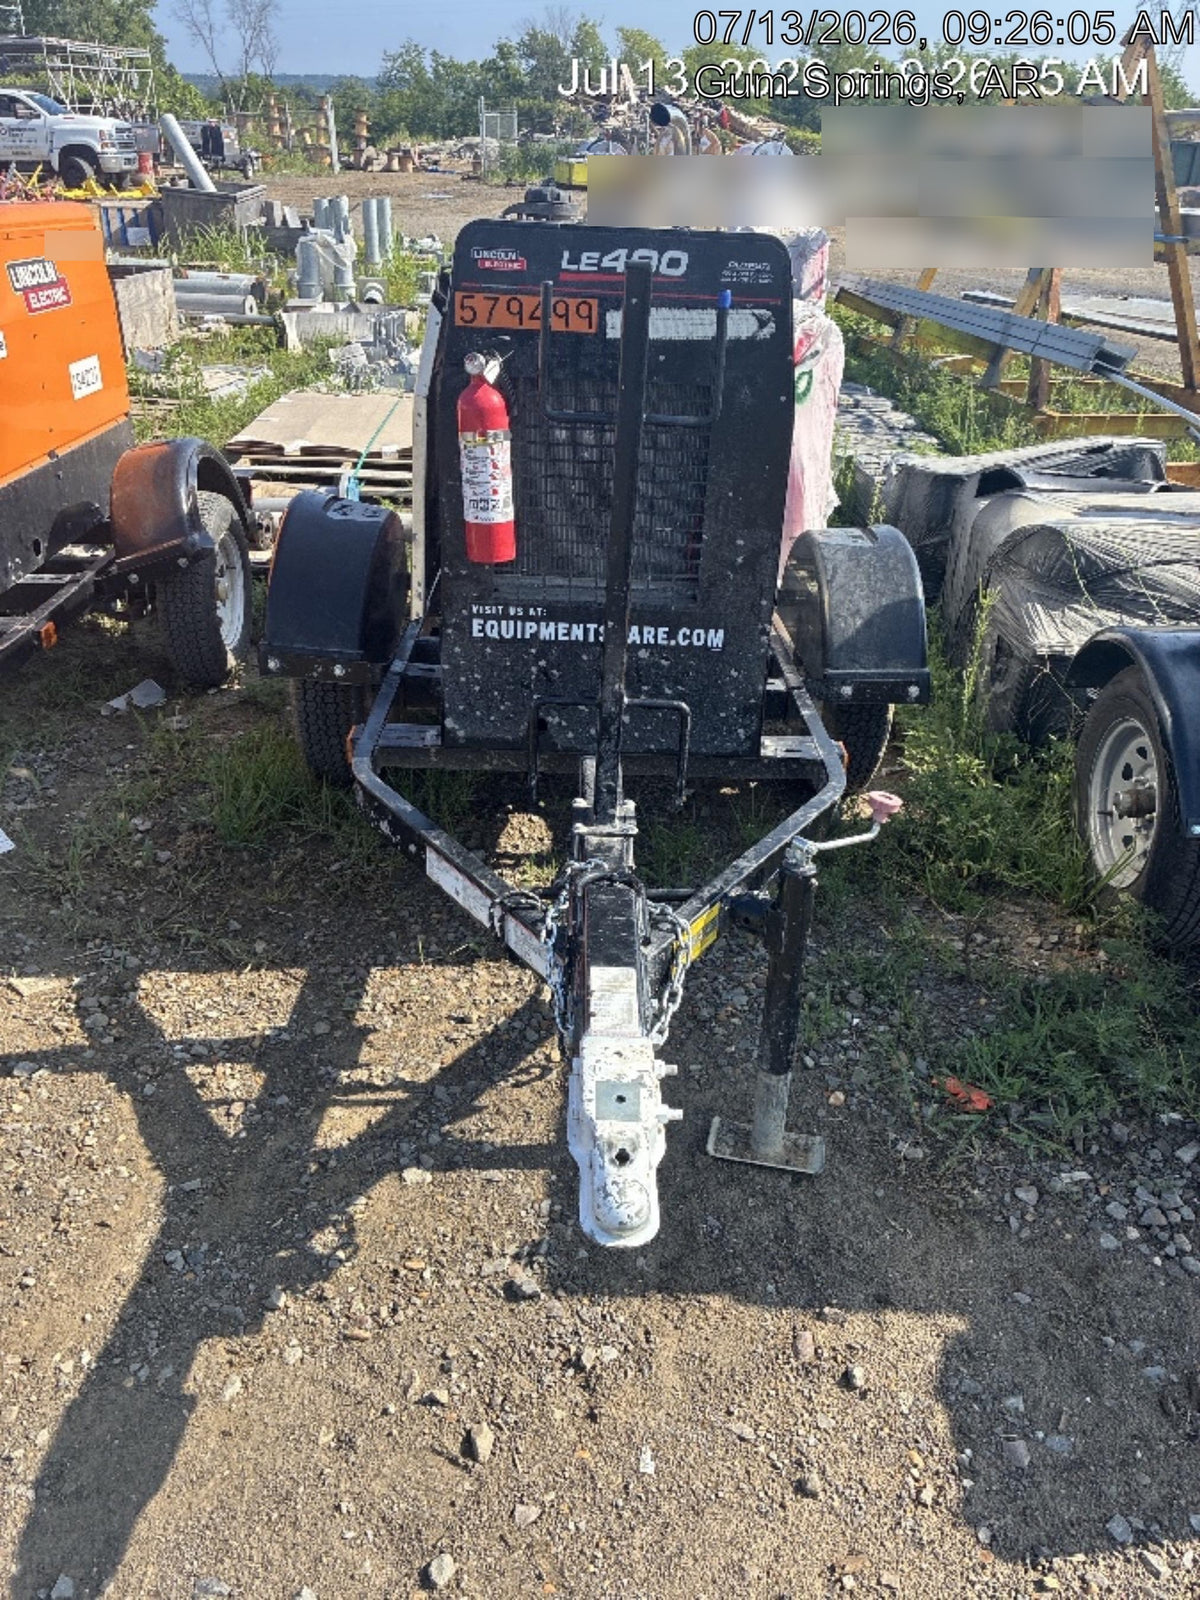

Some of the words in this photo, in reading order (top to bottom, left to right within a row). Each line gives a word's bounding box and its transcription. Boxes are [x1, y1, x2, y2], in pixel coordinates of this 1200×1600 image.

[474, 249, 517, 261] LINCOLN
[9, 259, 58, 290] LINCOLN
[28, 285, 68, 309] ELECTRIC
[472, 604, 503, 616] VISIT
[509, 606, 524, 616] US
[529, 606, 547, 617] AT:
[471, 618, 725, 650] EQUIPMENTSARE.COM
